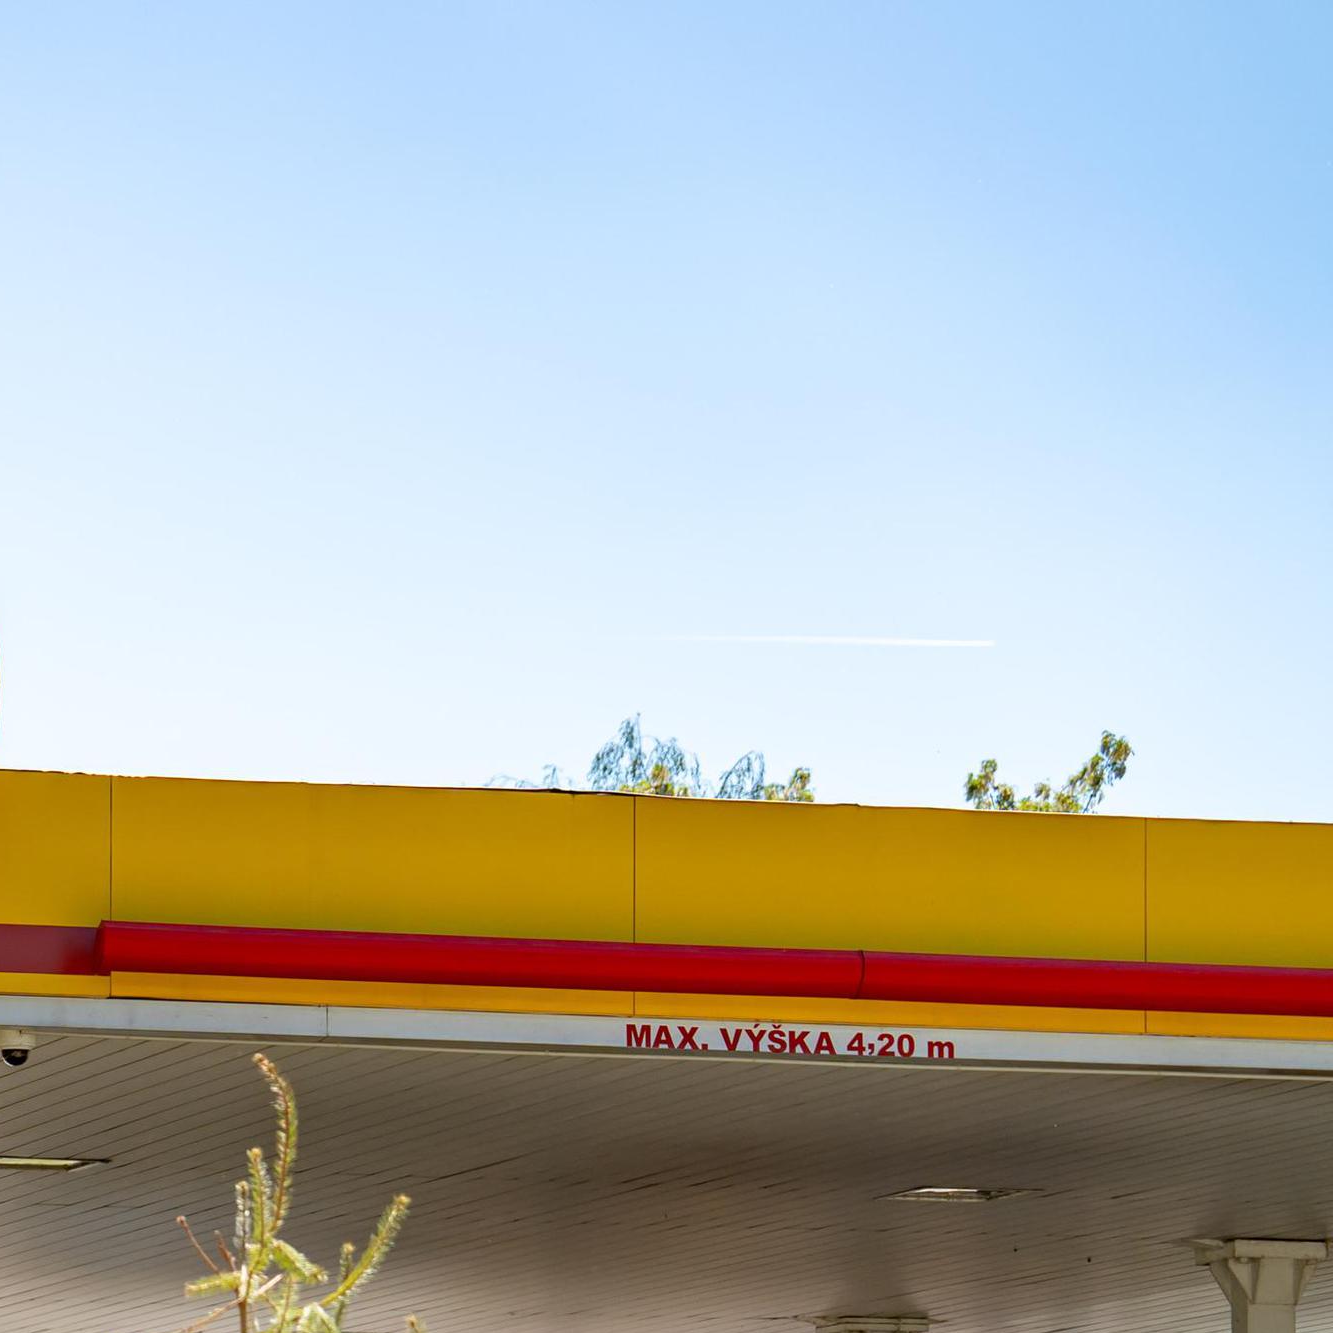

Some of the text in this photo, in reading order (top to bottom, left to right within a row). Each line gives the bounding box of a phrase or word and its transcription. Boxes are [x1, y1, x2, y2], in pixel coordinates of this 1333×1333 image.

[626, 1023, 955, 1059] MAX. VÝŠKA 4,20 m
